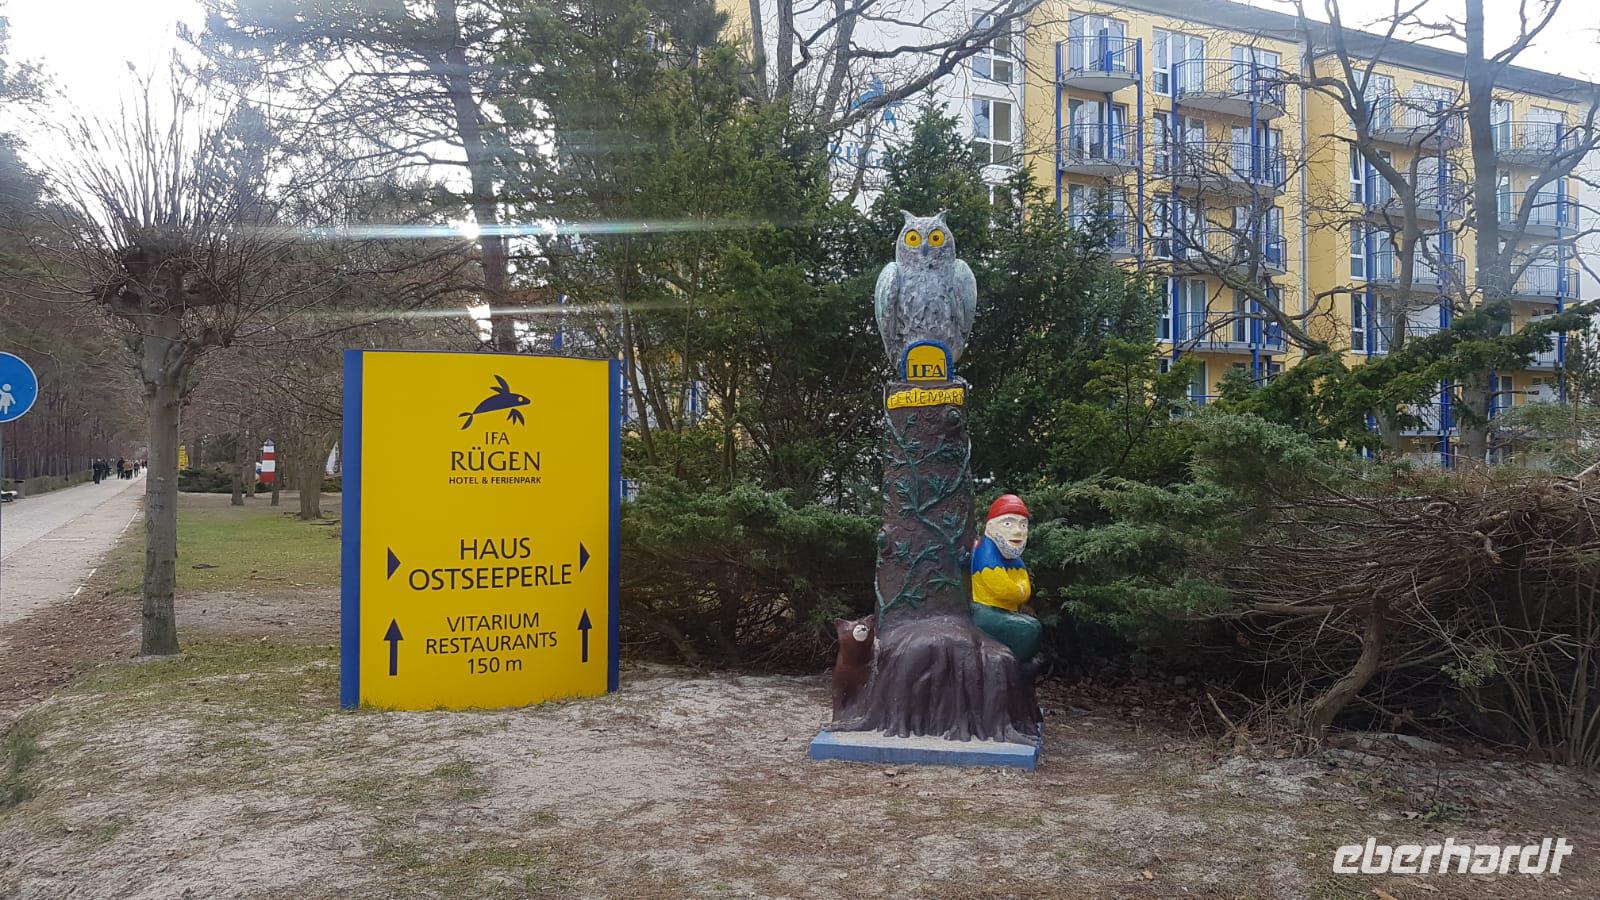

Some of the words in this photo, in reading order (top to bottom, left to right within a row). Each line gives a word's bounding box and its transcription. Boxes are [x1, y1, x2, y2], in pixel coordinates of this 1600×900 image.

[912, 364, 945, 378] IFA
[485, 431, 510, 445] IFA
[450, 446, 541, 471] RÜGEN
[448, 476, 479, 485] HOTEL
[481, 476, 488, 485] &
[490, 476, 542, 485] FERIENPARK
[460, 537, 531, 561] HAUS
[408, 564, 572, 591] OSTSEEPERLE
[446, 612, 540, 633] VITARIUM
[426, 632, 558, 655] RESTAURANTS
[467, 657, 500, 675] 150
[506, 659, 522, 672] m
